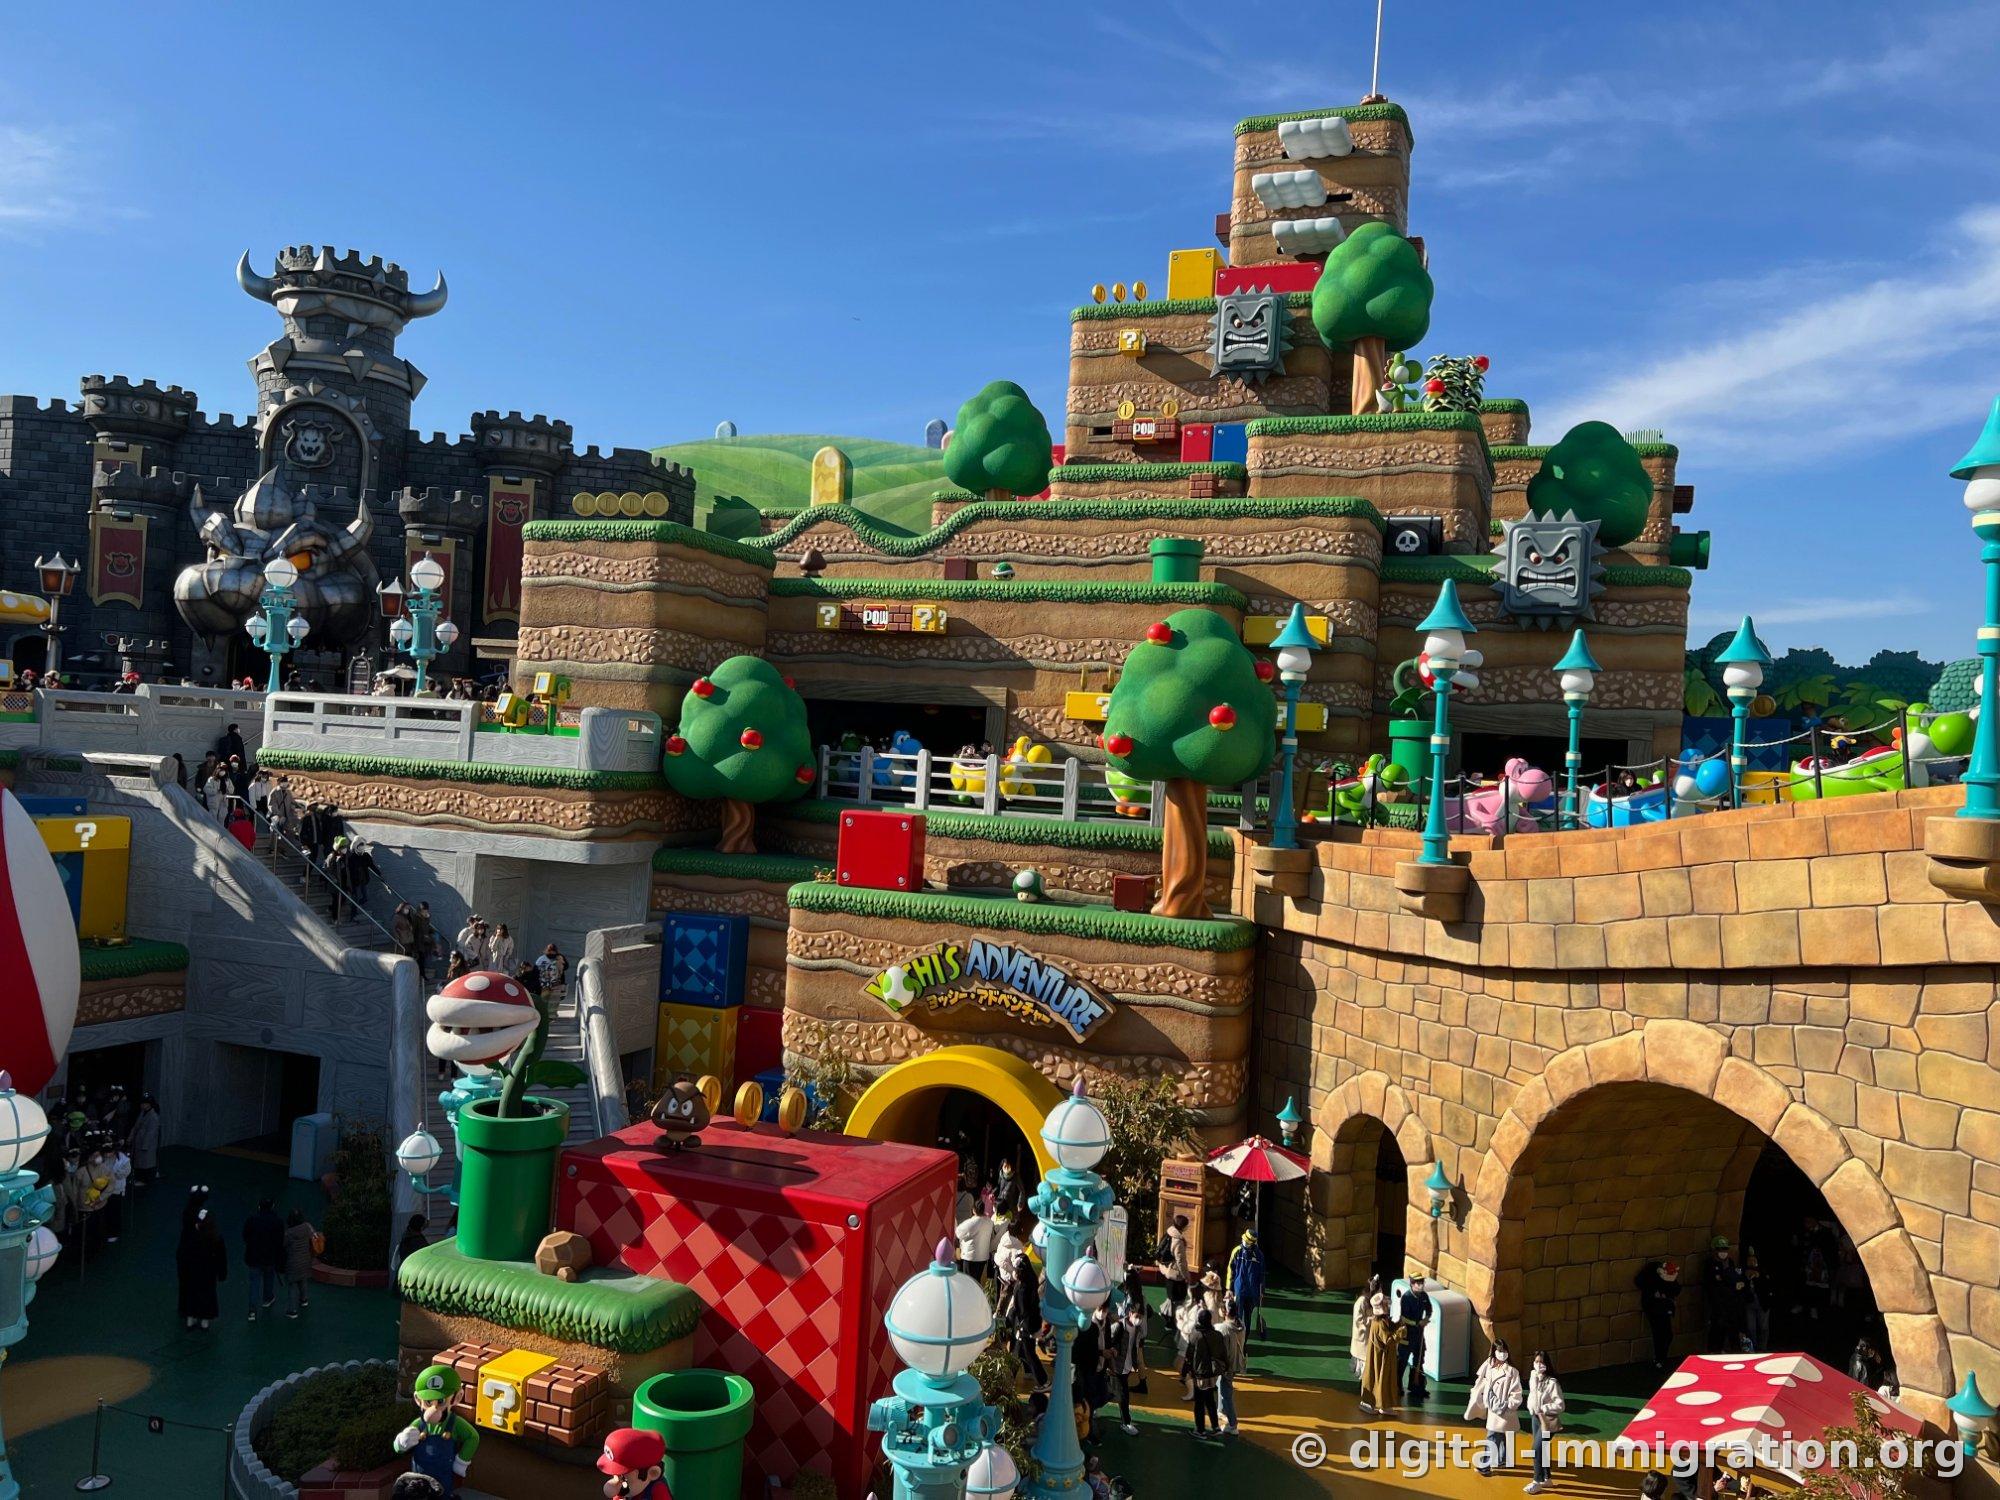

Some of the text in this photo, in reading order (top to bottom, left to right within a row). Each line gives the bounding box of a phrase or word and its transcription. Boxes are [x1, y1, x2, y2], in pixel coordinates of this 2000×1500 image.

[1134, 423, 1155, 434] POW
[863, 610, 889, 625] POW
[74, 822, 97, 848] ?
[964, 938, 1106, 1036] ADVENTURE
[926, 987, 1053, 1025] ヨッシー・アドベンチャー
[482, 1378, 517, 1427] ?
